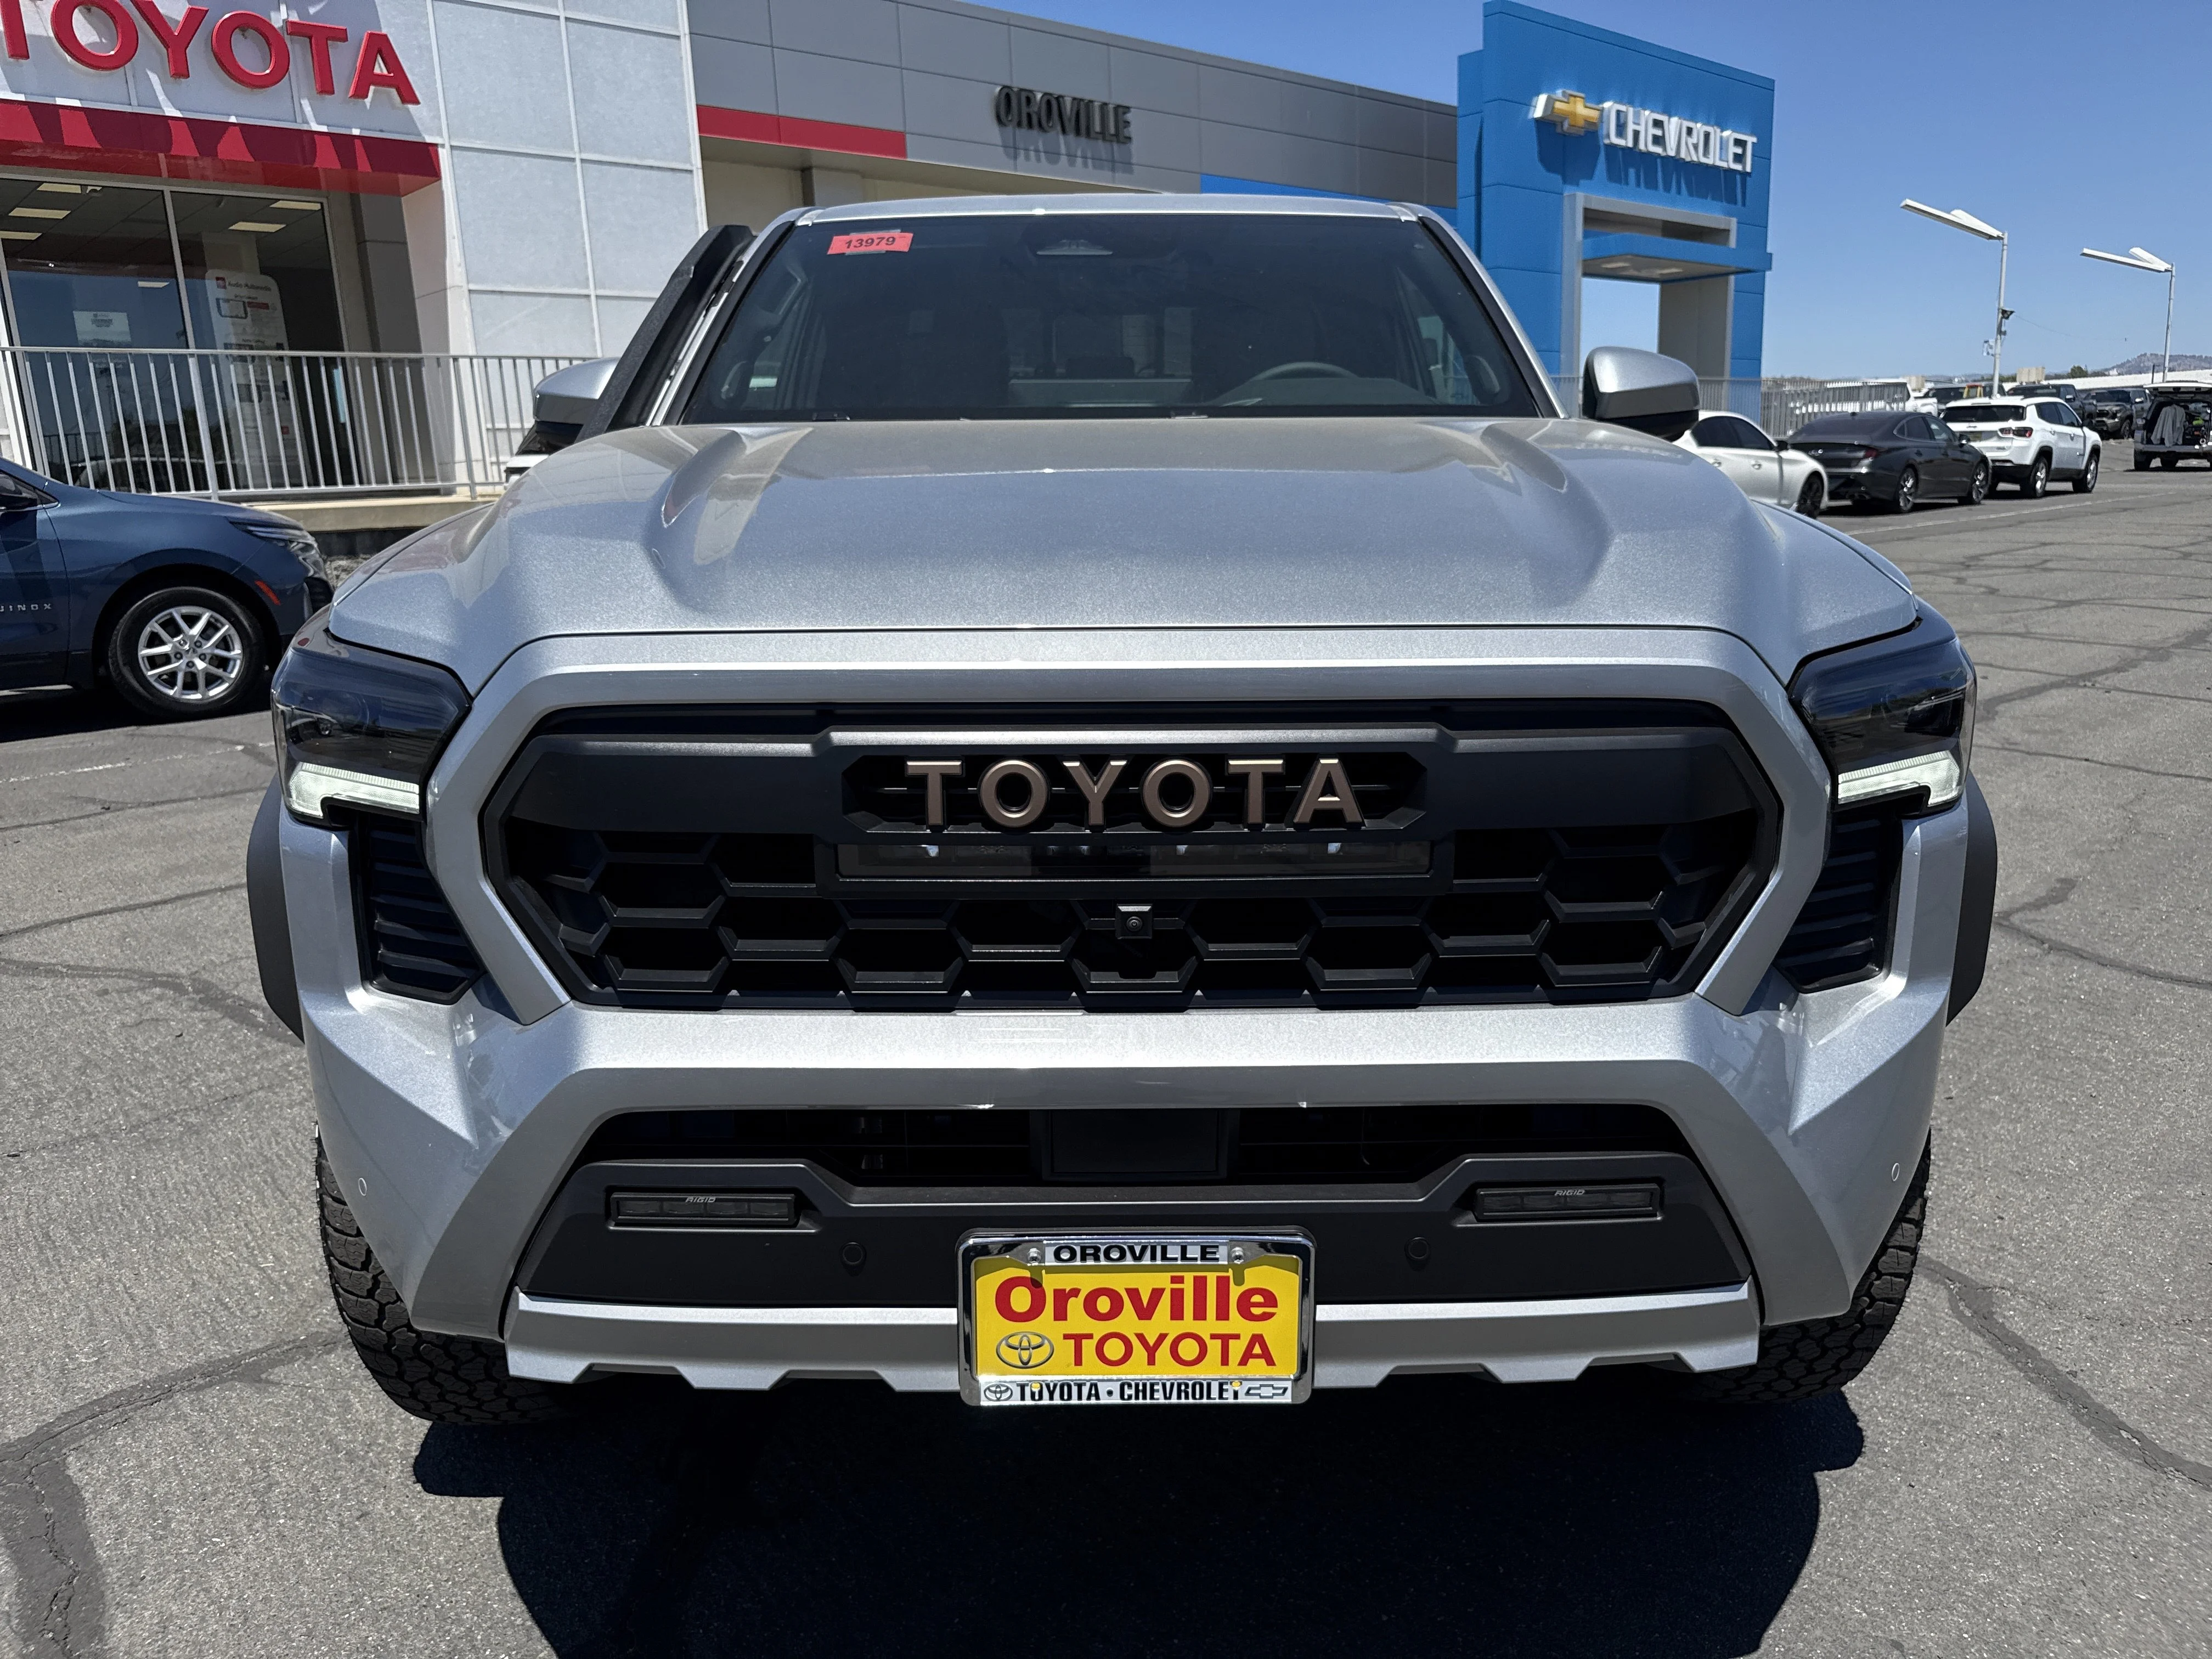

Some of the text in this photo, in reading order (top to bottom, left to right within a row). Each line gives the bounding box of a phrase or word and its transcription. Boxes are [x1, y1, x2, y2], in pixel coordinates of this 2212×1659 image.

[995, 86, 1132, 143] OROVILLE
[1602, 101, 1757, 173] CHEVROLET
[845, 236, 896, 249] 13979
[907, 758, 1364, 827] TOYOTA
[1053, 1244, 1220, 1262] OROVILLE
[995, 1275, 1278, 1323] Oroville
[1063, 1331, 1277, 1367] TOYOTA
[1017, 1380, 1242, 1402] TOYOTA CHEVROLET
